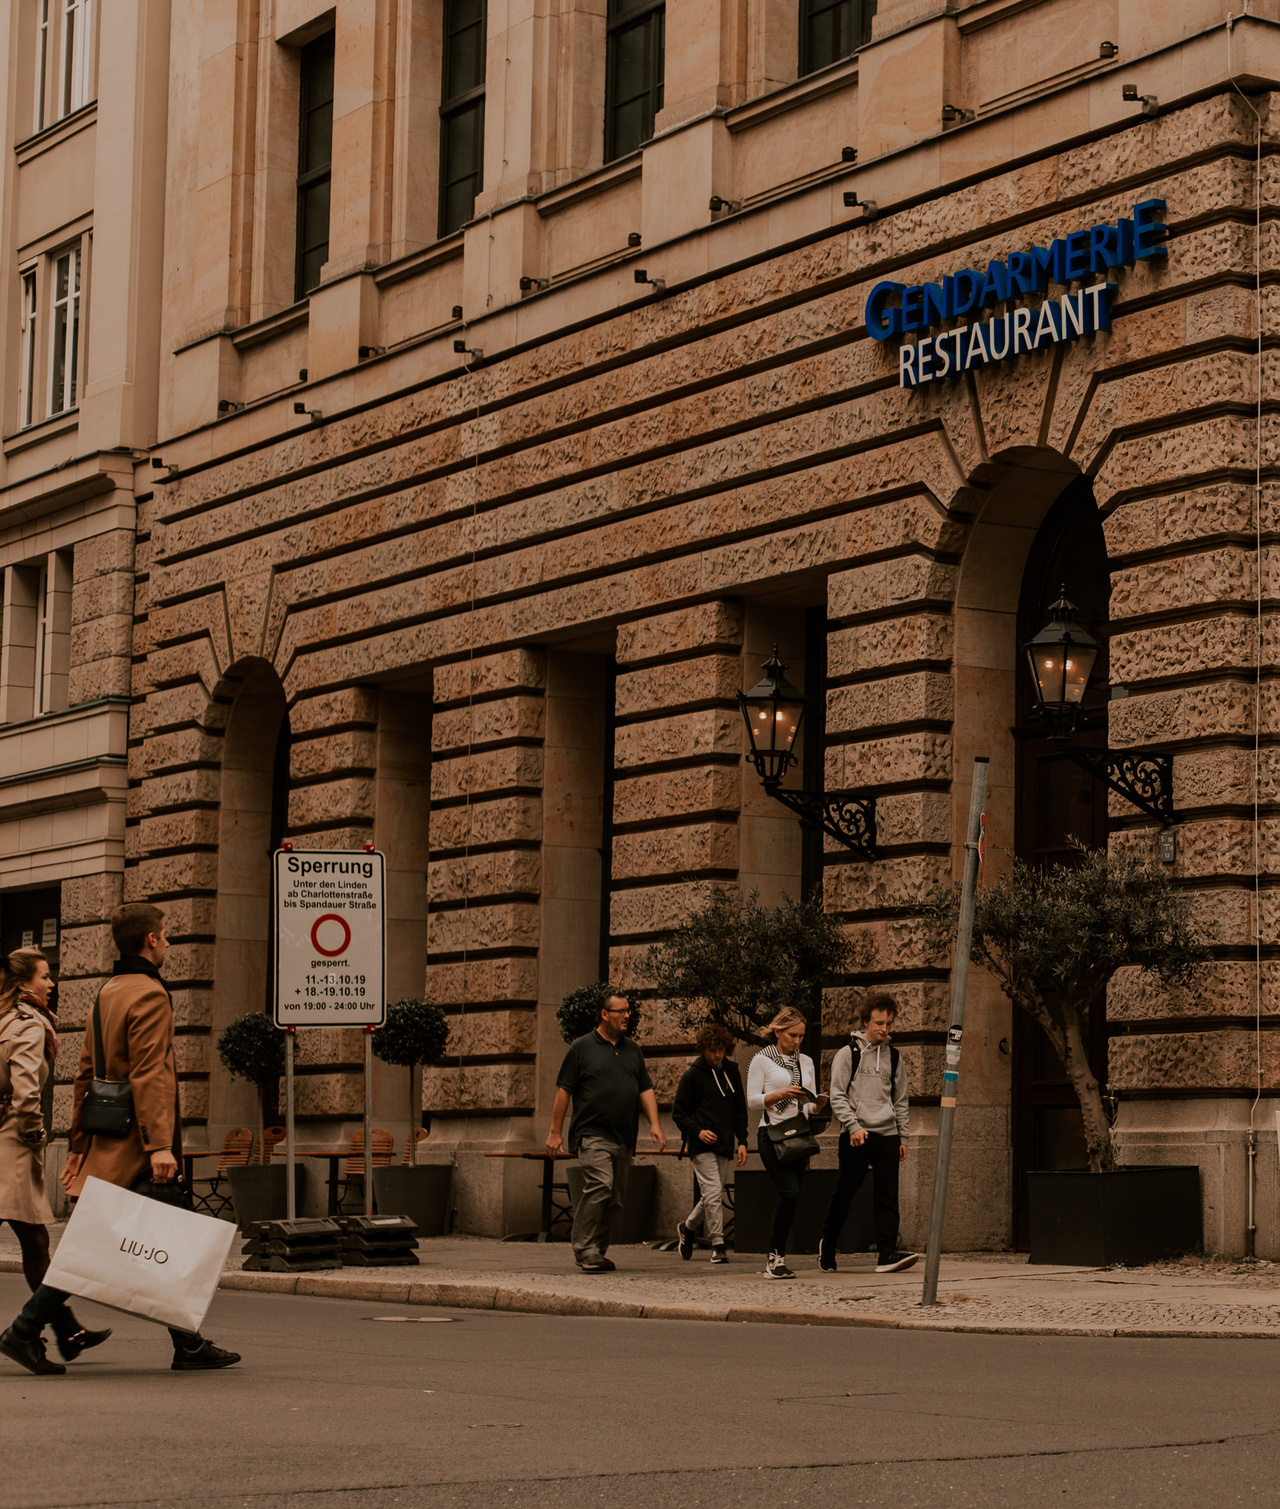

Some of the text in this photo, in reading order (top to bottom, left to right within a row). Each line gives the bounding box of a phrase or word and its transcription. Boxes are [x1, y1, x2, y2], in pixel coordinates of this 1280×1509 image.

[864, 198, 1168, 341] GENDARMERIE
[900, 282, 1115, 389] RESTAURANT
[287, 856, 374, 878] Sperrung
[293, 879, 368, 890] Unter den Linden
[287, 890, 373, 900] ab Charlottenstraße
[284, 900, 377, 910] bis Spandauer Straße
[310, 959, 350, 968] gesperrt.
[305, 974, 366, 985] 11.-13.10.19
[304, 986, 366, 997] 18.-19.10.19
[303, 1002, 327, 1011] 19:00
[334, 1002, 357, 1011] 24:00
[360, 1002, 375, 1011] Uhr
